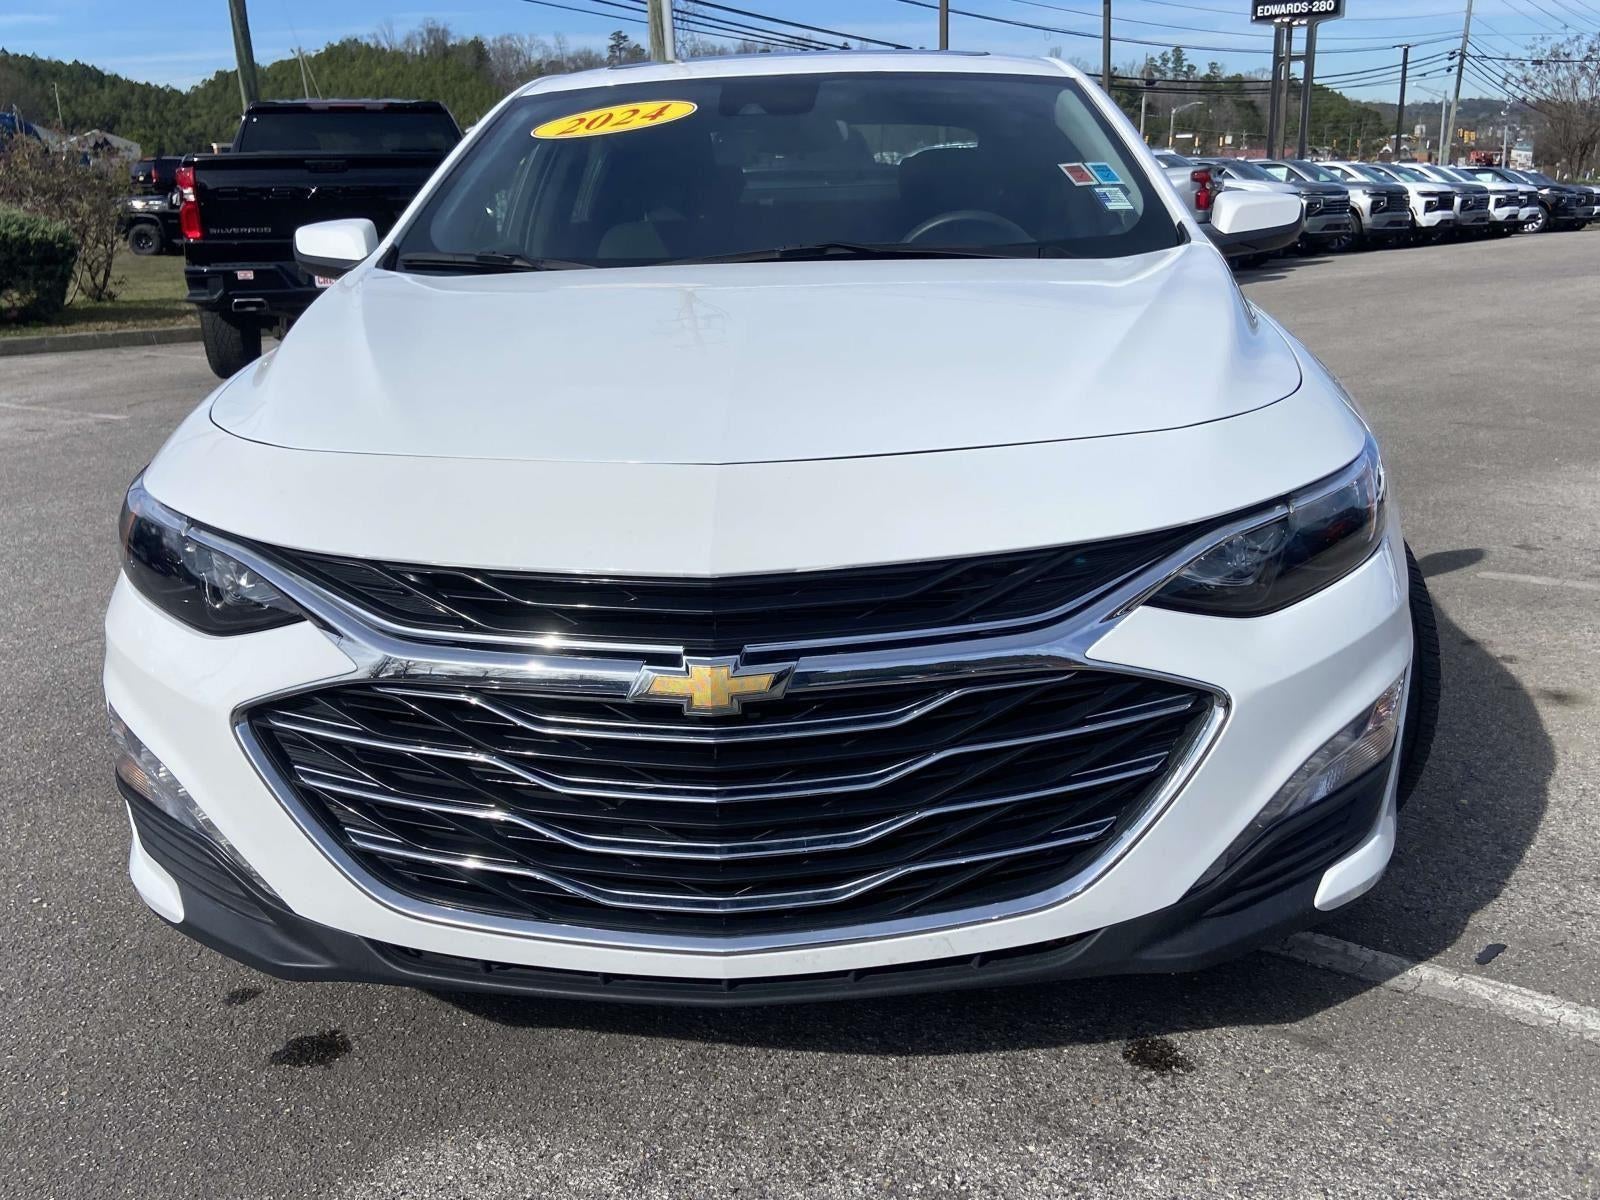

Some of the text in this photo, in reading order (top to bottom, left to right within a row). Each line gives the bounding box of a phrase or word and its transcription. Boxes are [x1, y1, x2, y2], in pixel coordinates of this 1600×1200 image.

[1257, 0, 1335, 16] EDWARDS-280
[555, 103, 673, 136] 2024
[209, 227, 272, 235] SILVERADO
